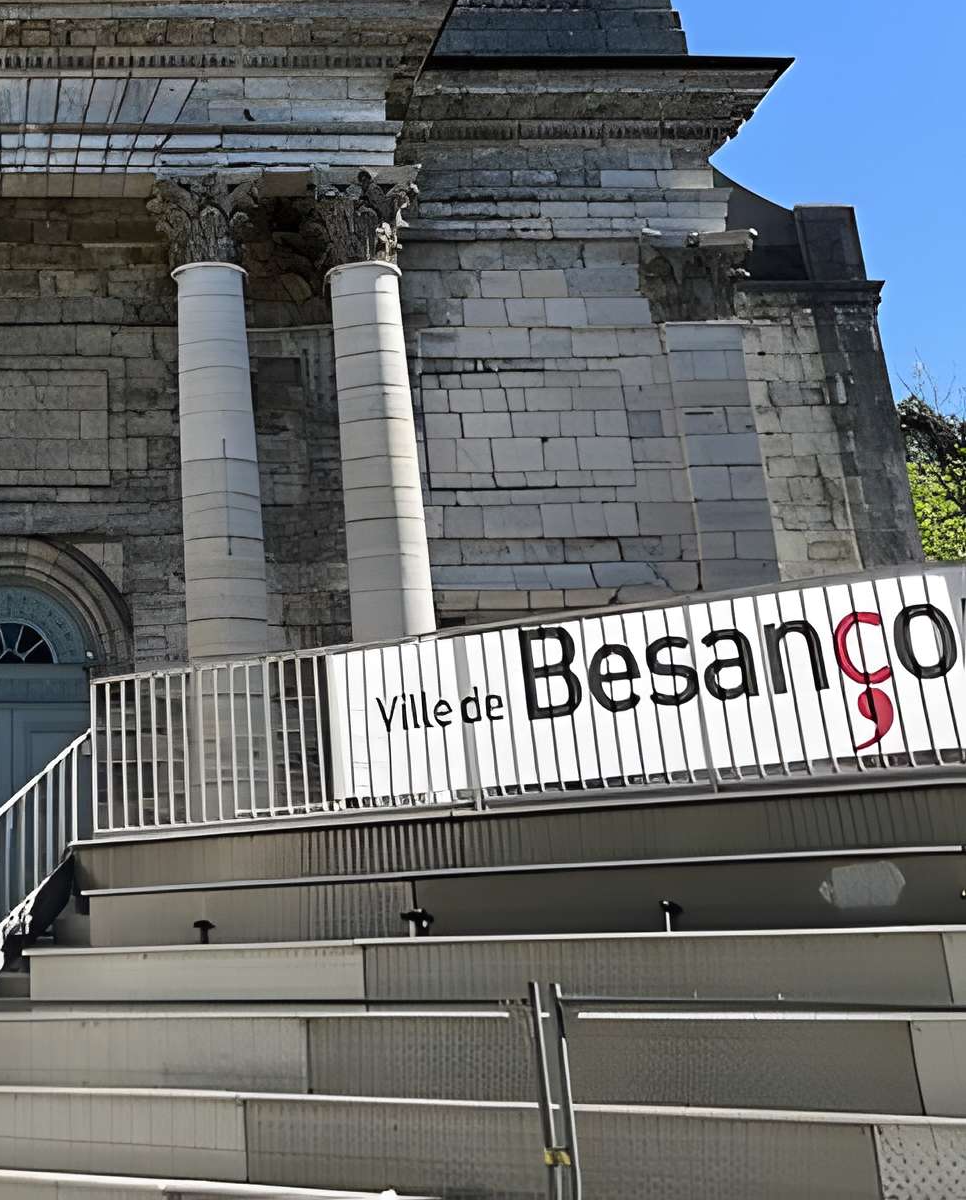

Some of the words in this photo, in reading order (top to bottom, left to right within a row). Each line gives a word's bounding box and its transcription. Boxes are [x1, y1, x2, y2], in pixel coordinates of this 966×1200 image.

[375, 691, 453, 733] Ville
[460, 686, 504, 724] de
[518, 598, 966, 751] Besanço
